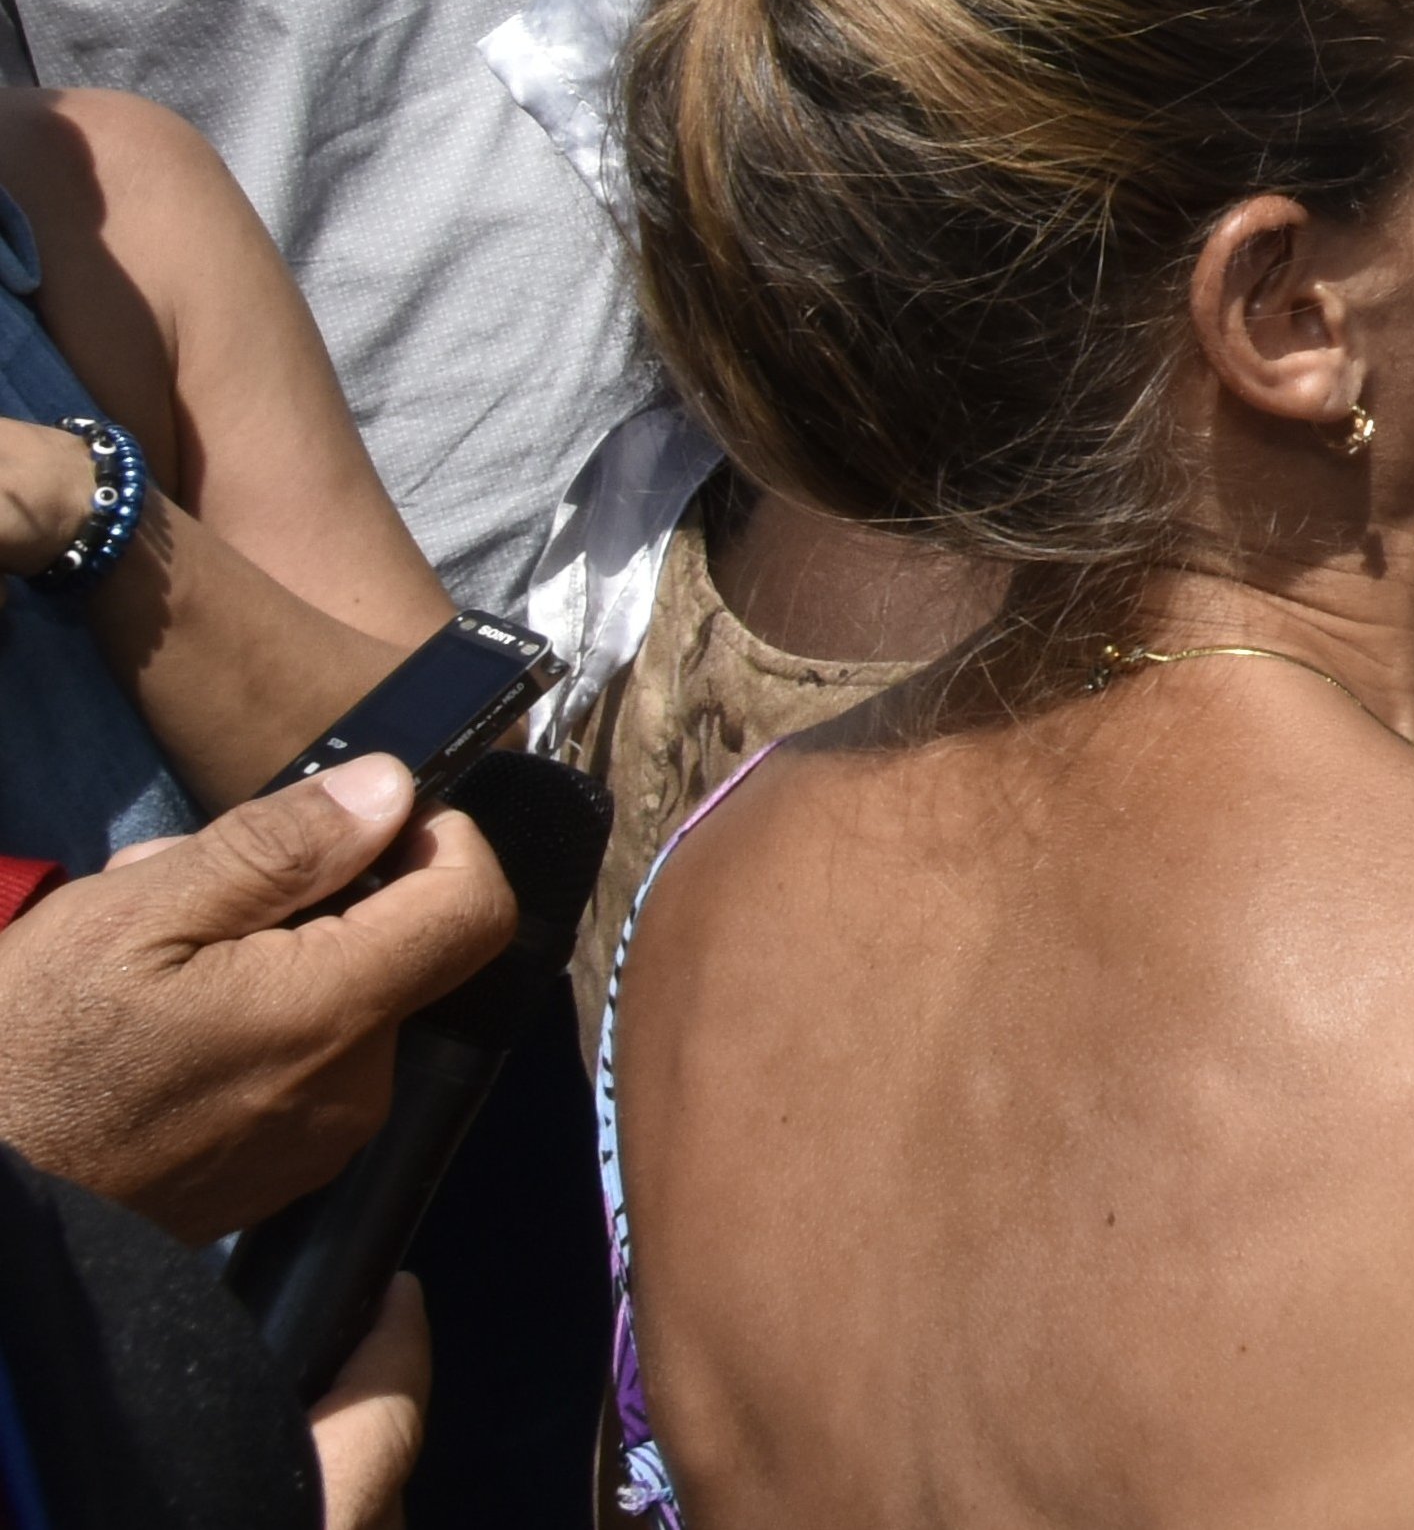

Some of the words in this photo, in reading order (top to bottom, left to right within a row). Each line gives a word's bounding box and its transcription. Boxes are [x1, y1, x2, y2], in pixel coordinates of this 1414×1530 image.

[477, 624, 517, 645] SONY
[444, 728, 475, 757] POWER
[501, 681, 525, 705] HOLD
